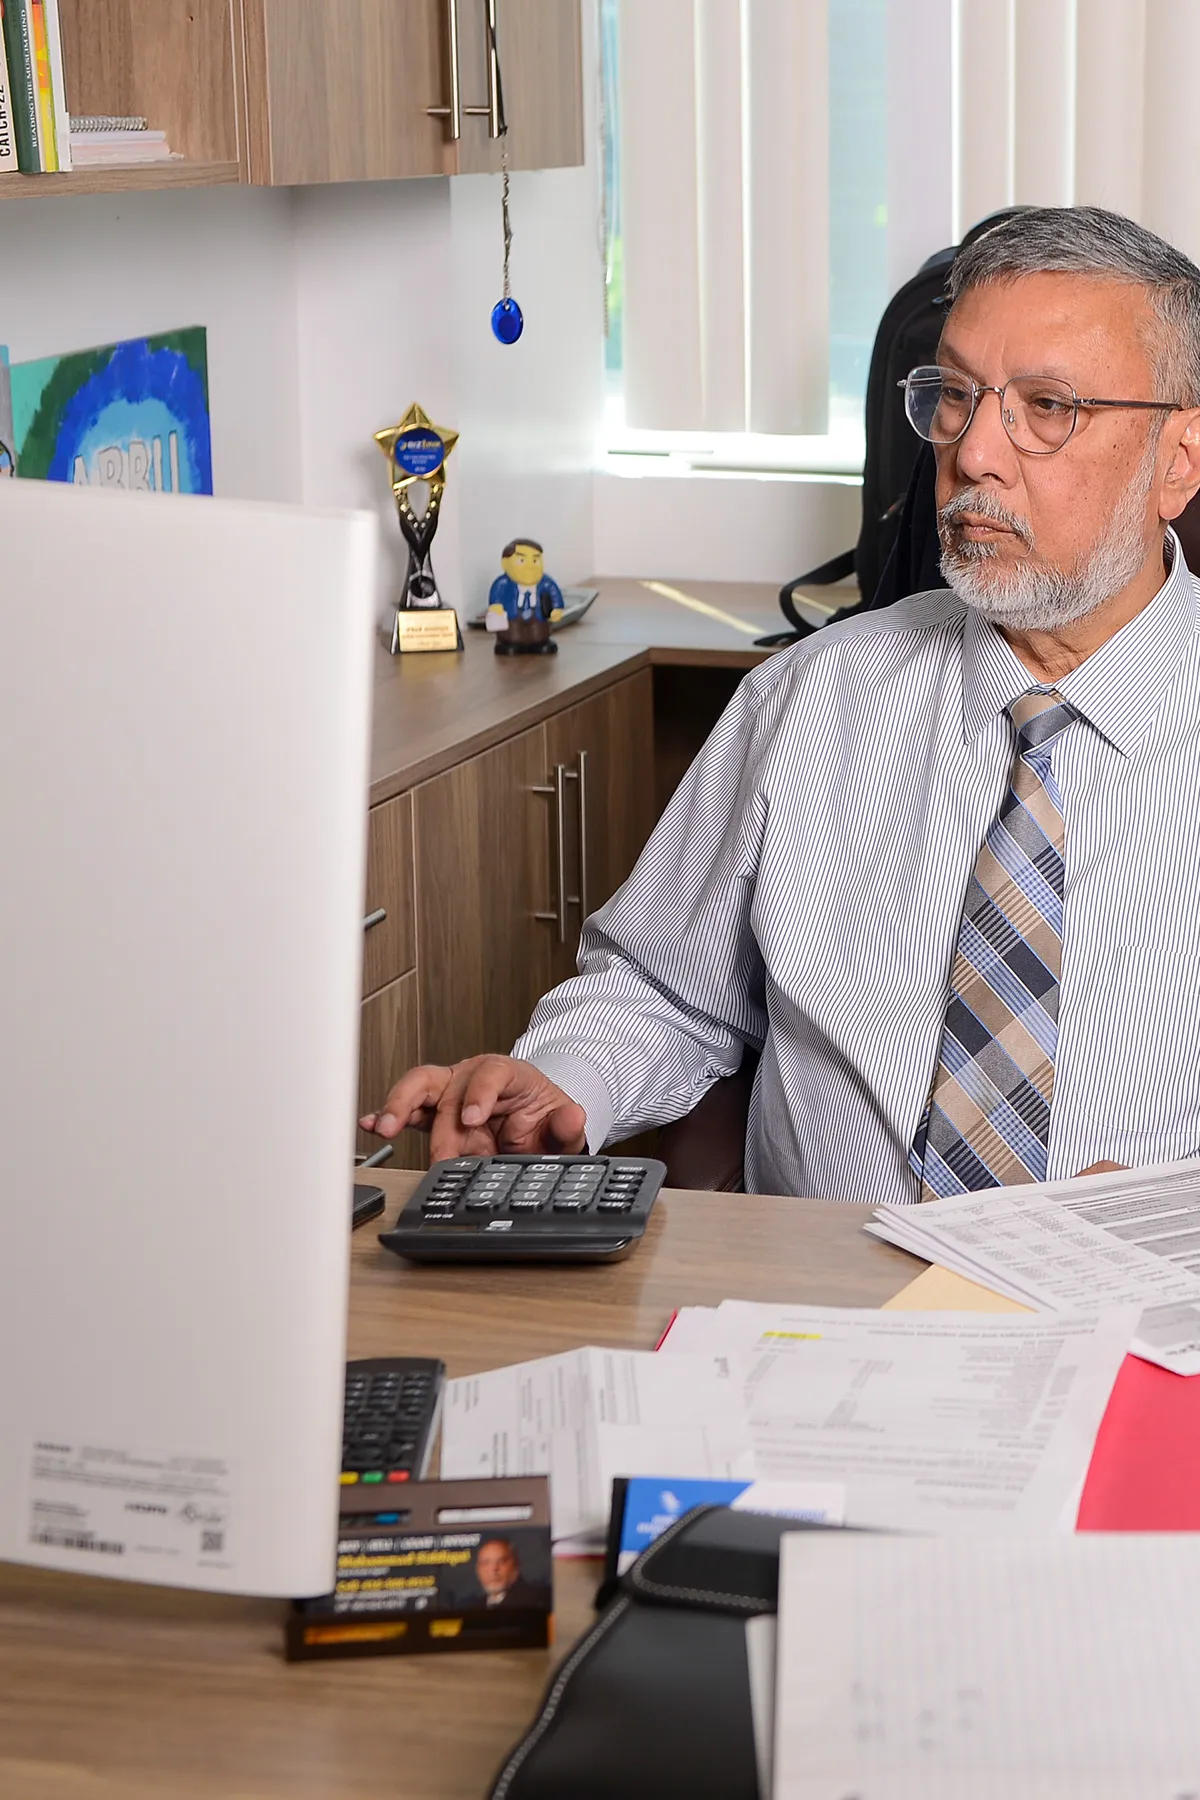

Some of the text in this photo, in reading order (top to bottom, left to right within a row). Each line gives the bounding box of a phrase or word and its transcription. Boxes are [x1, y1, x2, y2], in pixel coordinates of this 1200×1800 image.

[20, 9, 28, 37] MIND
[24, 38, 33, 79] MUSLIM
[28, 102, 38, 147] READING
[491, 1172, 506, 1180] 3
[564, 1191, 581, 1199] 7
